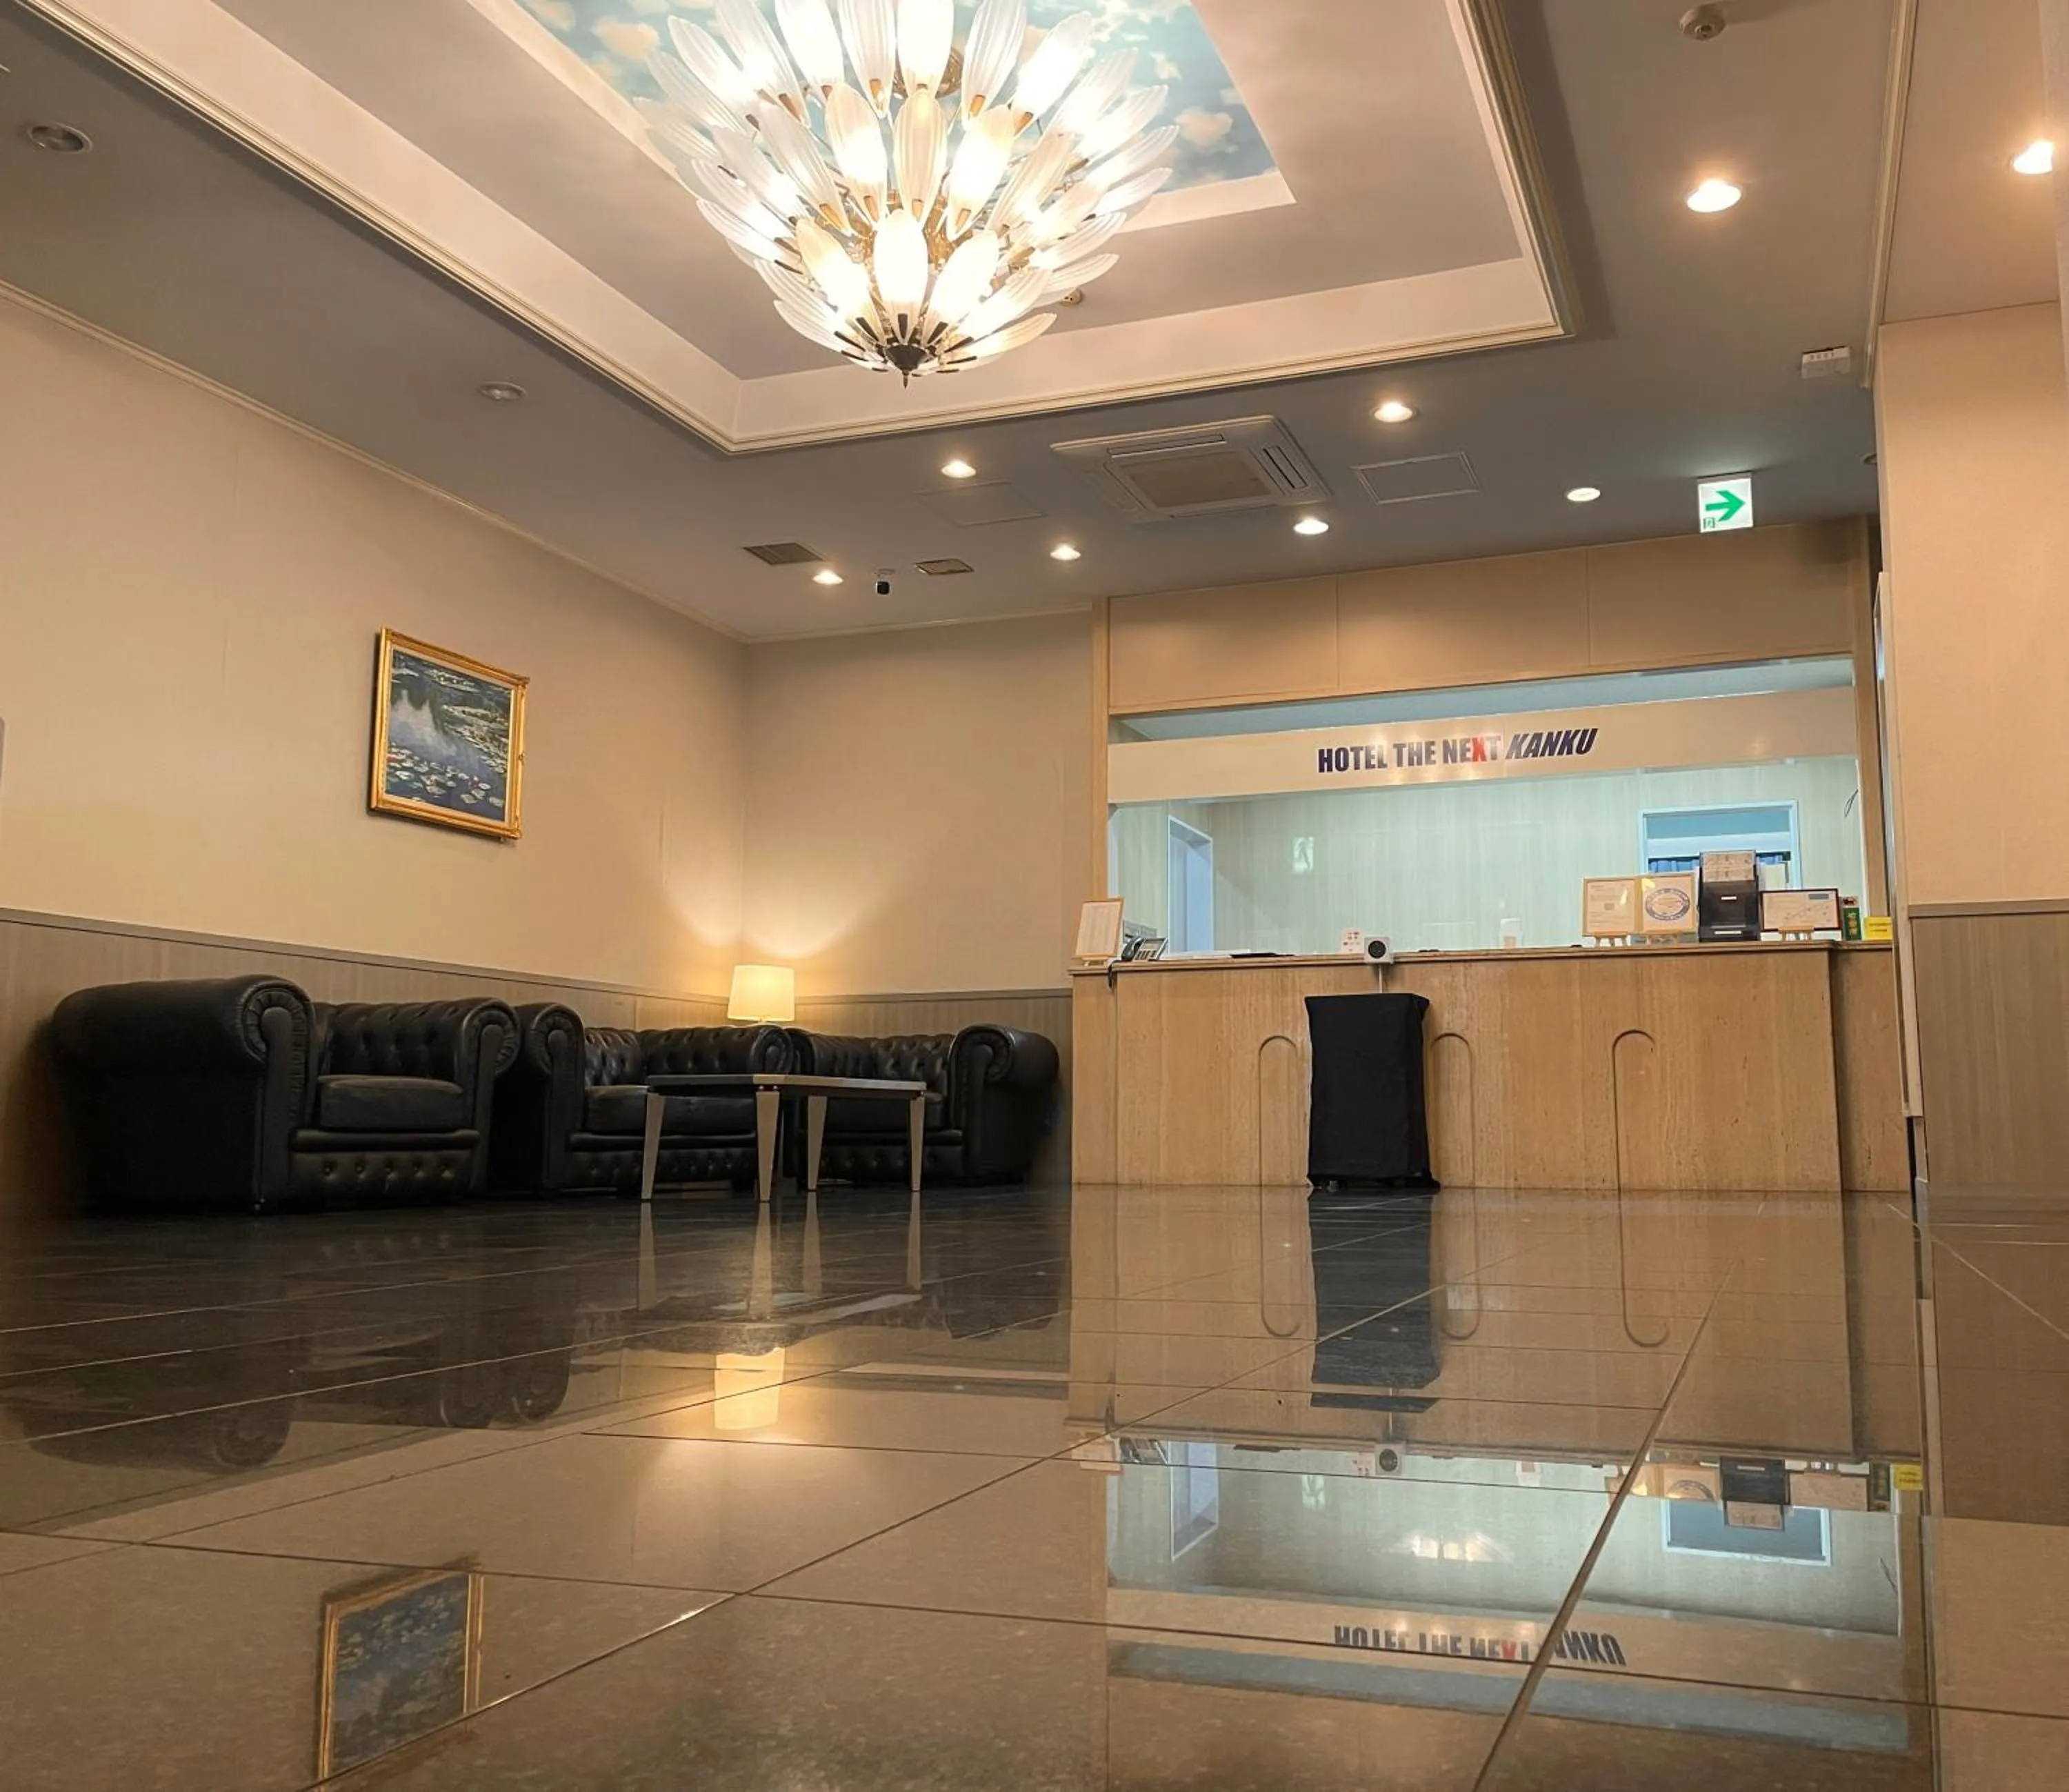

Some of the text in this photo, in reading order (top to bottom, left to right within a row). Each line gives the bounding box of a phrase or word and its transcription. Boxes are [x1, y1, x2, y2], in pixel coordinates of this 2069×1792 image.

[1318, 728, 1598, 773] HOTEL THE NEXT KANKU
